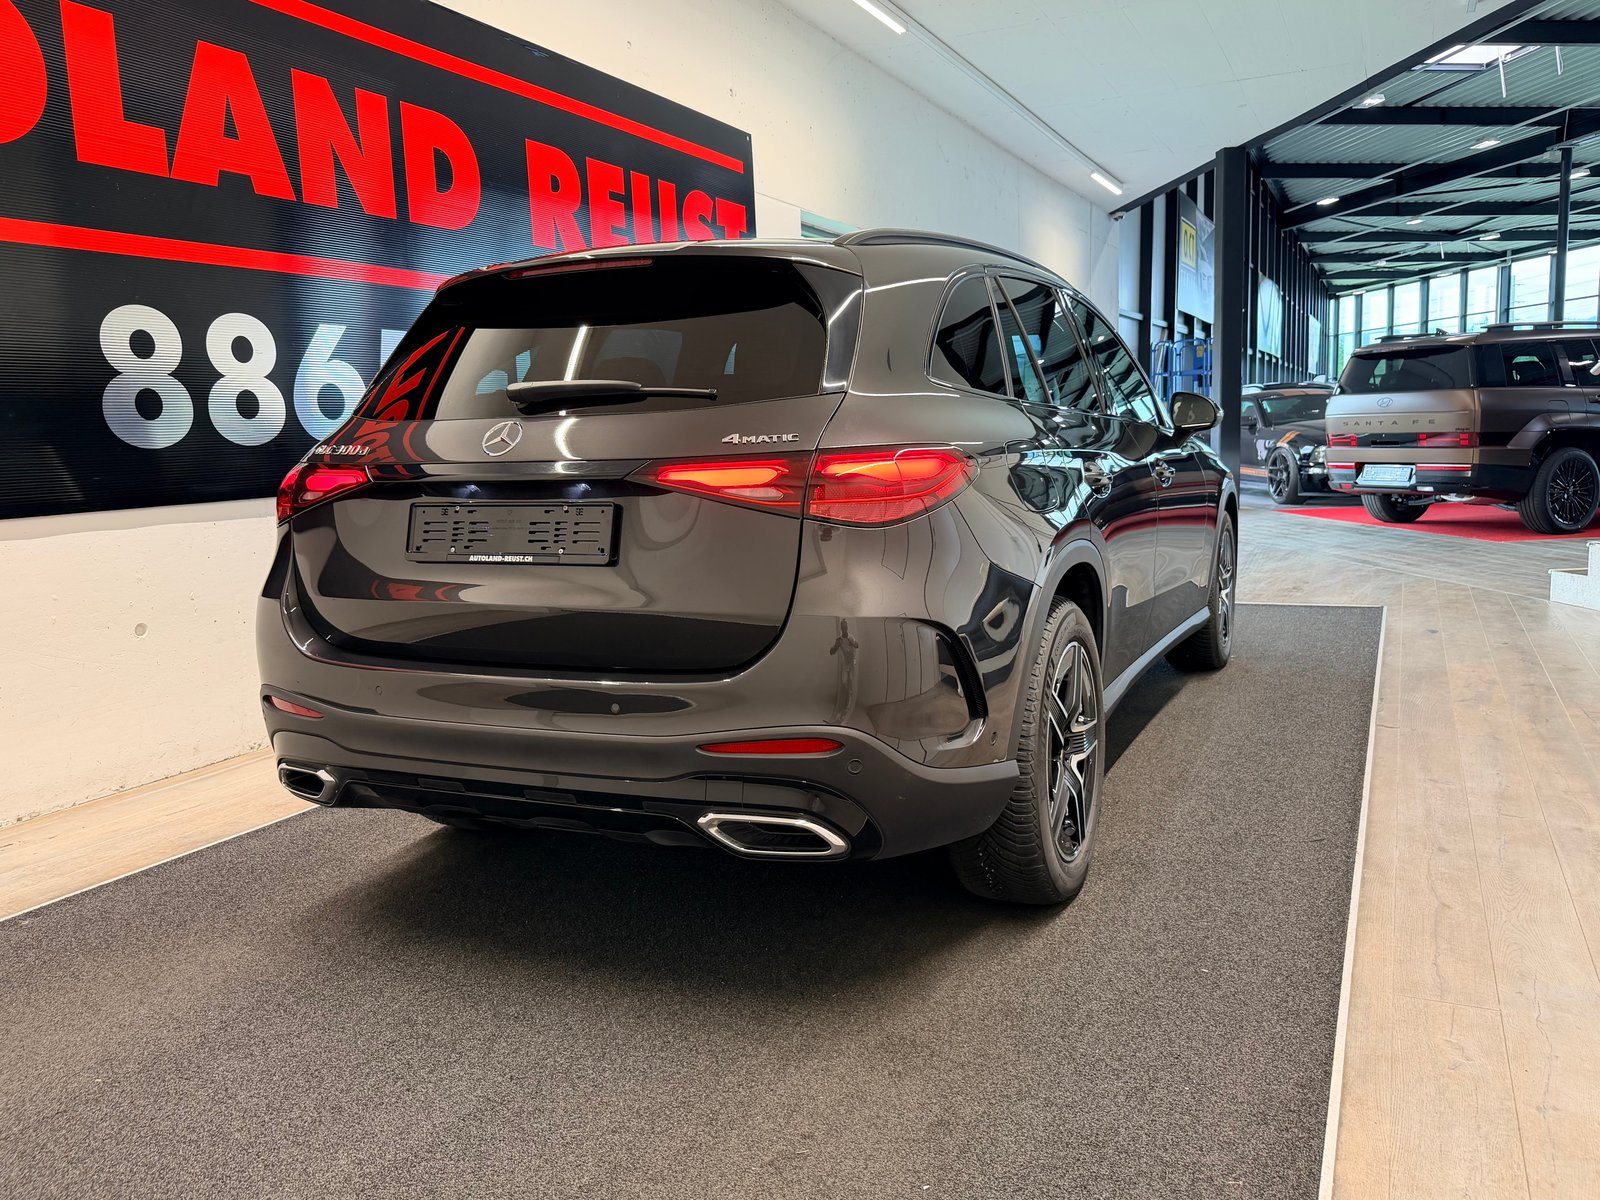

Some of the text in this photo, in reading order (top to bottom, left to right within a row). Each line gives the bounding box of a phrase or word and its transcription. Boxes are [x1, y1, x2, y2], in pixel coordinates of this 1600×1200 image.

[525, 138, 748, 251] REUST
[1342, 418, 1437, 427] SANTA FE
[721, 433, 800, 444] 4MATIC
[468, 554, 534, 563] AUTOLAND-REUST.CH
